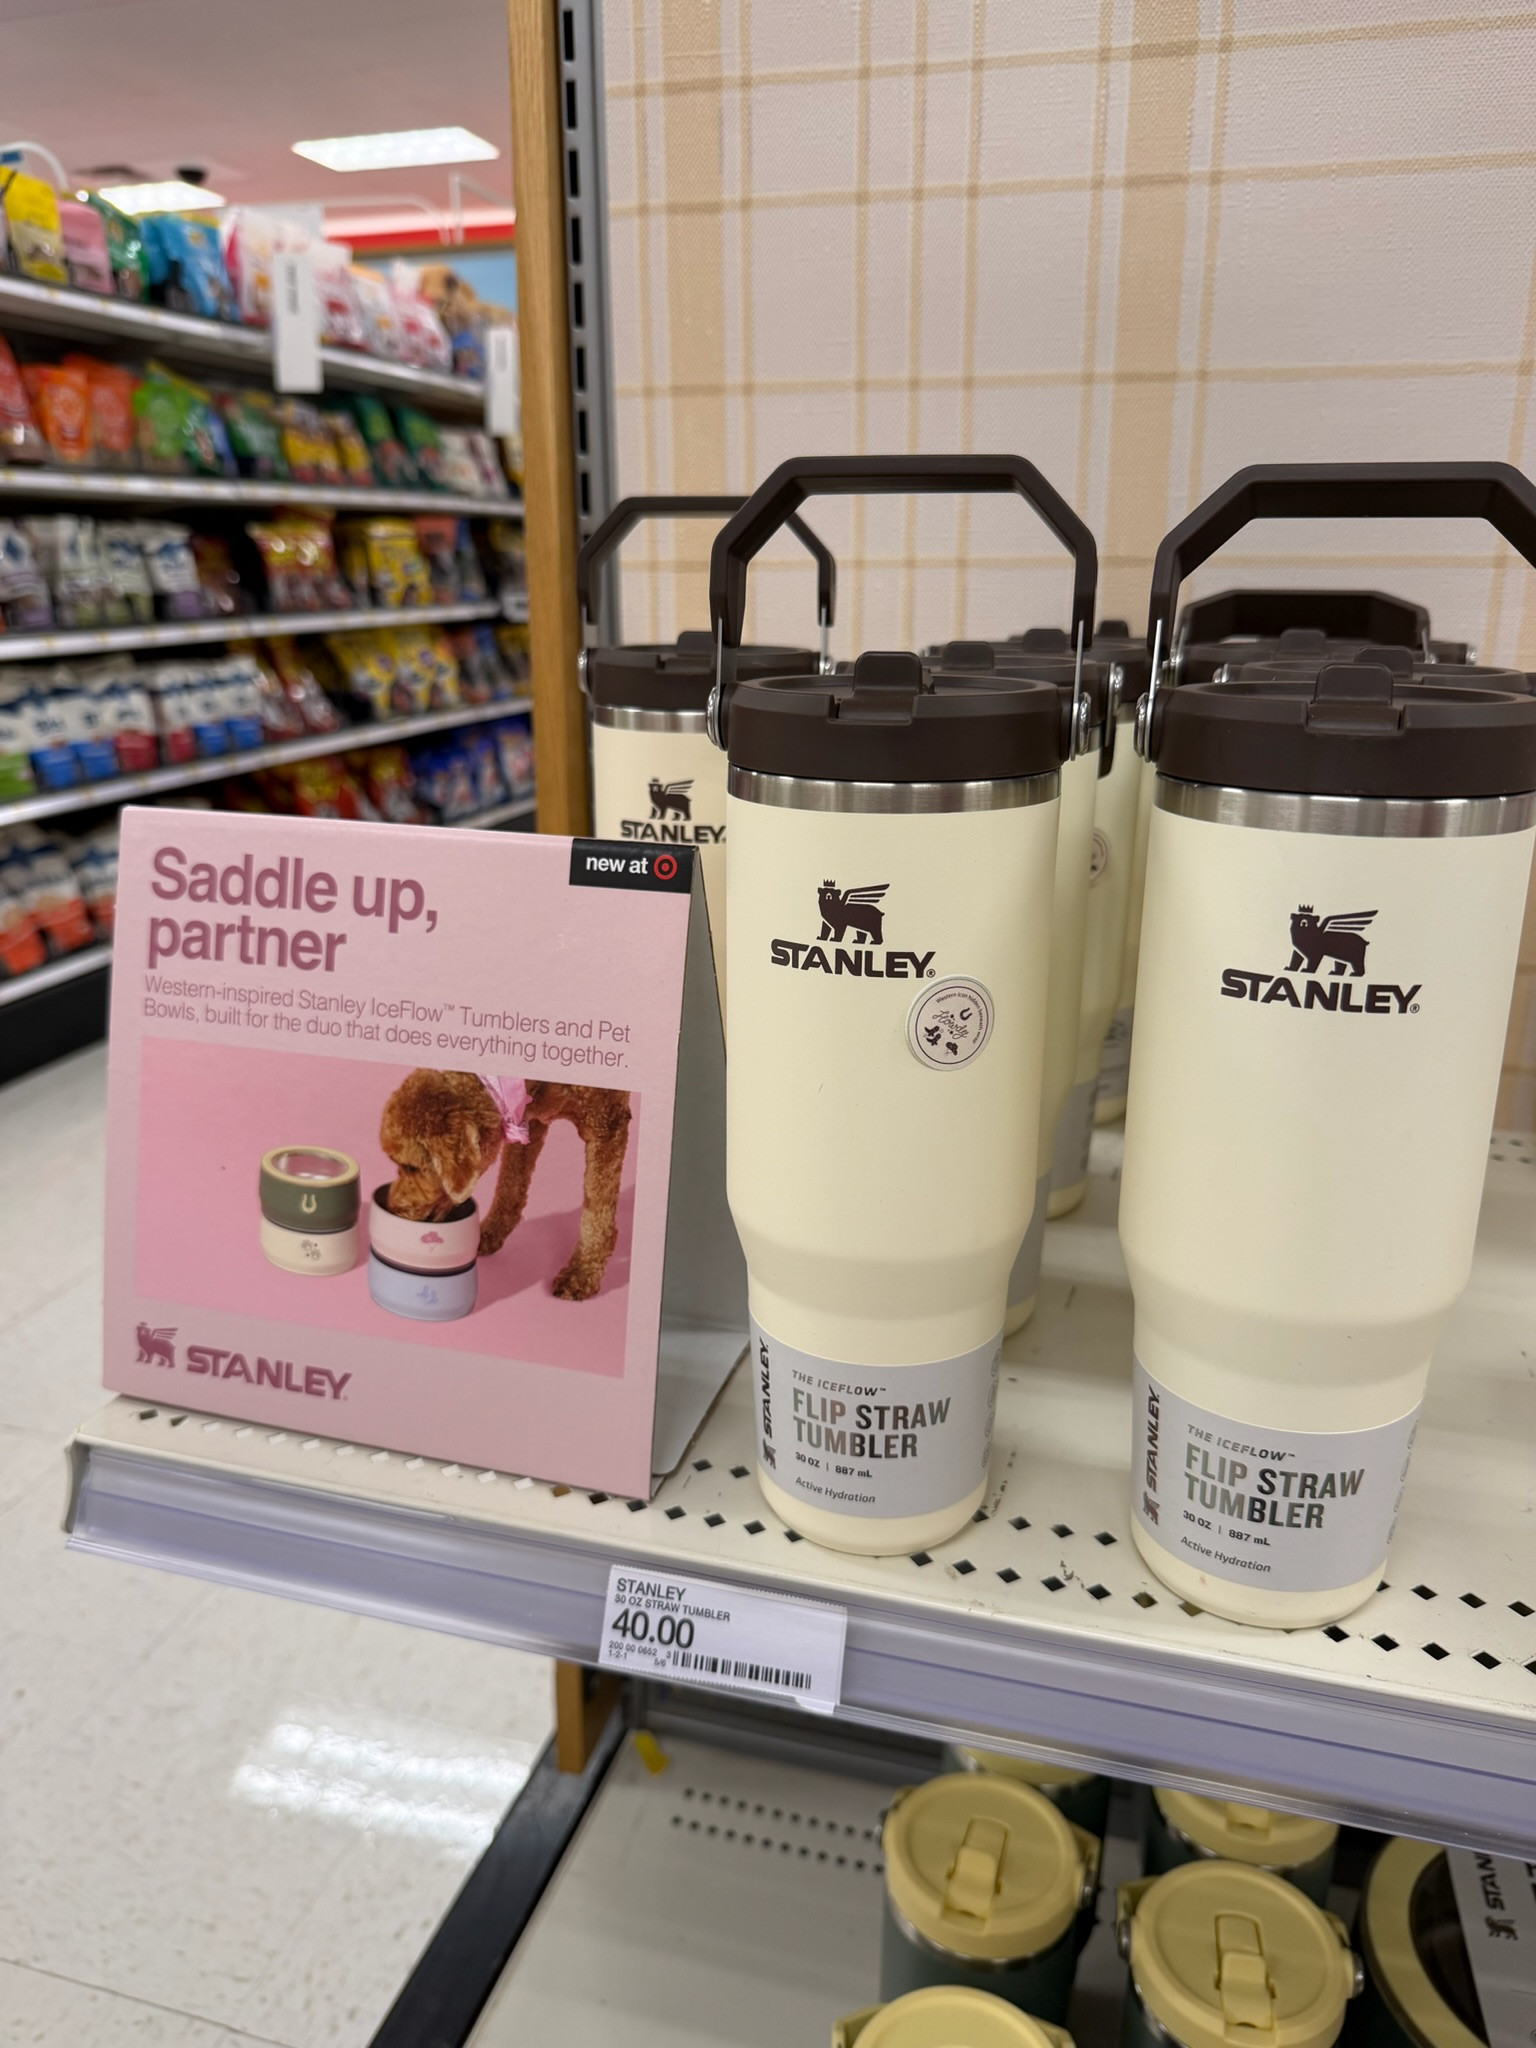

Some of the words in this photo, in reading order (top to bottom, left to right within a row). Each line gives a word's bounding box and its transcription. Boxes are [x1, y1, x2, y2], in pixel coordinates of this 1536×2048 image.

[586, 854, 626, 873] new
[629, 857, 648, 875] at
[151, 847, 338, 914] Saddle
[353, 874, 438, 934] up,
[148, 915, 347, 973] partner
[144, 974, 294, 1007] Western-inspired
[299, 989, 366, 1019] Stanley
[460, 1005, 550, 1034] Tumblers
[555, 1020, 592, 1039] and
[599, 1021, 631, 1043] Pet
[932, 1010, 969, 1040] Howdy
[144, 998, 199, 1024] Bowls,
[205, 1005, 241, 1026] built
[247, 1008, 270, 1028] for
[274, 1012, 301, 1032] the
[307, 1017, 341, 1036] duo
[347, 1021, 380, 1041] that
[386, 1025, 431, 1046] does
[437, 1033, 536, 1062] everything
[542, 1041, 629, 1068] together.
[792, 1369, 814, 1386] THE
[792, 1386, 847, 1425] FLIP
[855, 1396, 951, 1431] STRAW
[793, 1415, 918, 1459] TUMBLER
[1187, 1423, 1213, 1443] THE
[795, 1451, 807, 1464] 30
[808, 1456, 820, 1468] OZ
[835, 1464, 855, 1476] 887
[857, 1468, 872, 1478] mL
[1185, 1441, 1248, 1487] FLIP
[1256, 1467, 1365, 1499] STRAW
[795, 1476, 822, 1495] Active
[825, 1486, 876, 1504] Hydration
[1184, 1471, 1325, 1529] TUMBLER
[1182, 1509, 1197, 1524] 30
[1197, 1514, 1212, 1530] OZ
[1228, 1528, 1251, 1542] 887
[1253, 1535, 1271, 1547] mL
[1180, 1535, 1212, 1557] Active
[1213, 1550, 1272, 1574] Hydration
[617, 1577, 686, 1601] STANLEY
[615, 1593, 627, 1604] 30
[629, 1596, 643, 1607] OZ
[645, 1598, 680, 1613] STRAW
[682, 1604, 731, 1621] TUMBLER
[611, 1607, 695, 1649] 40.00
[608, 1640, 624, 1650] 200
[625, 1643, 636, 1653] 00
[637, 1645, 658, 1656] 0652
[666, 1650, 672, 1659] 3
[608, 1649, 628, 1660] 1-2-1
[654, 1658, 667, 1668] 5/6
